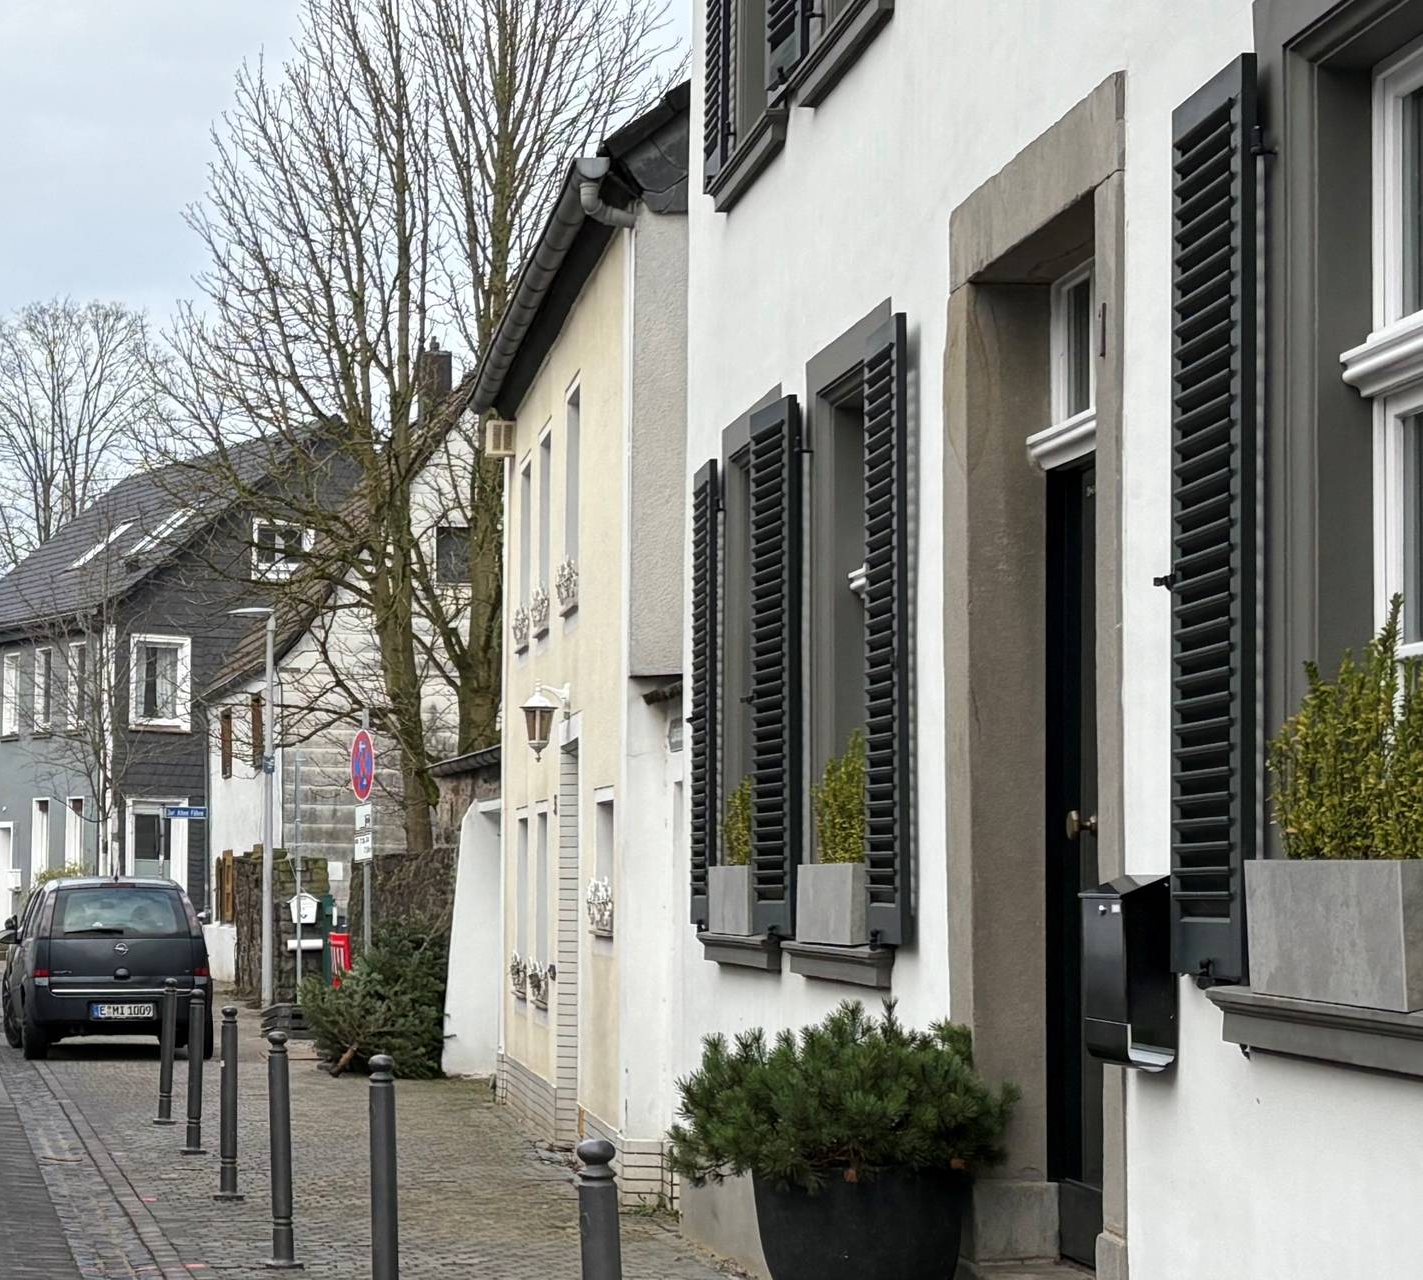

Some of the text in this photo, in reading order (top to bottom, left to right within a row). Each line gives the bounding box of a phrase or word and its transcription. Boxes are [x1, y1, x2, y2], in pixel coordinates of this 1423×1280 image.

[100, 1005, 152, 1015] E MI 1009
